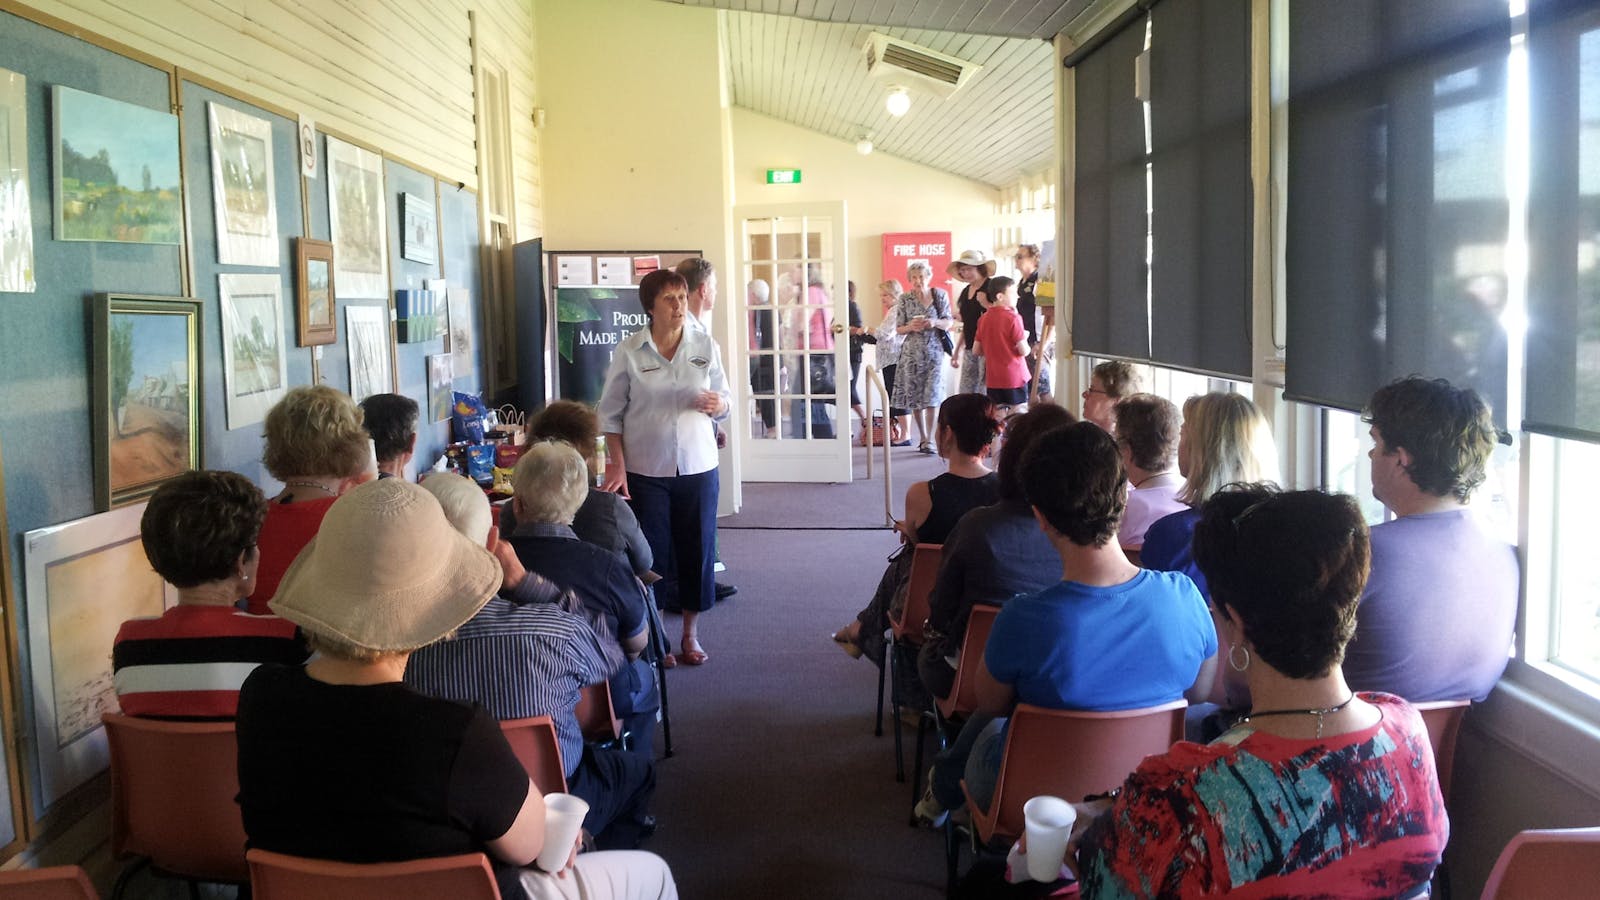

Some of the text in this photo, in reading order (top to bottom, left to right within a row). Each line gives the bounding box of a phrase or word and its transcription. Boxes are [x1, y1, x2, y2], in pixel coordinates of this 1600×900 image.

[893, 243, 946, 256] FIRE HOSE
[613, 311, 650, 326] PROU
[579, 330, 618, 345] MADE
